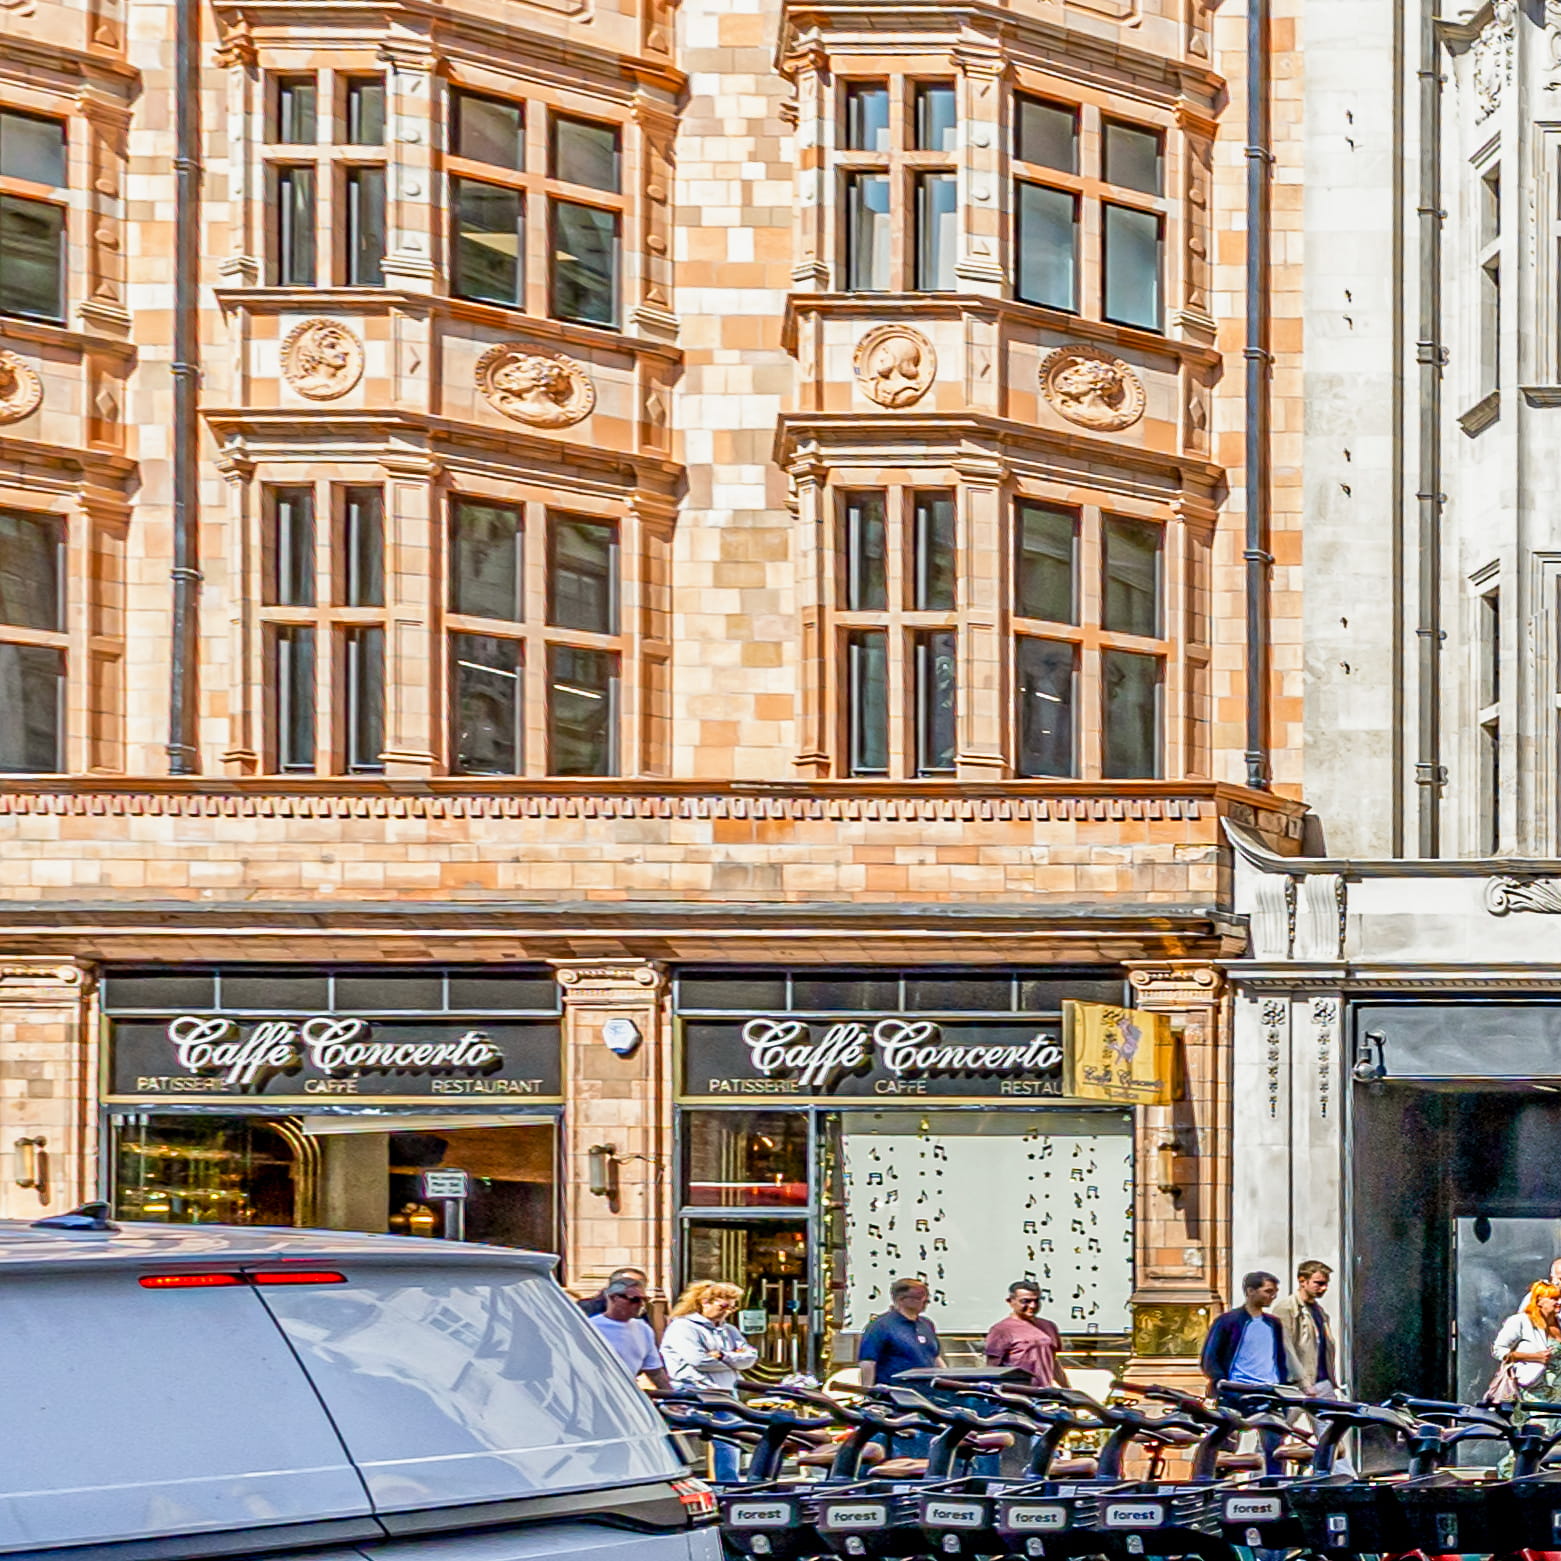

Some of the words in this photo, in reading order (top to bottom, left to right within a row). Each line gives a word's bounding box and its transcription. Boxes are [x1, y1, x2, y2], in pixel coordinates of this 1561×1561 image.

[302, 1017, 494, 1075] Concerto
[873, 1018, 1062, 1076] Concerto
[432, 1078, 543, 1093] RESTAURANT
[709, 1079, 800, 1093] PATISSERIE
[1001, 1080, 1063, 1095] RESTAU
[737, 1509, 782, 1520] forest
[932, 1508, 975, 1521] forest
[1233, 1503, 1273, 1514] forest
[833, 1511, 877, 1522] forest
[1014, 1512, 1057, 1524] forest
[1113, 1509, 1155, 1521] forest
